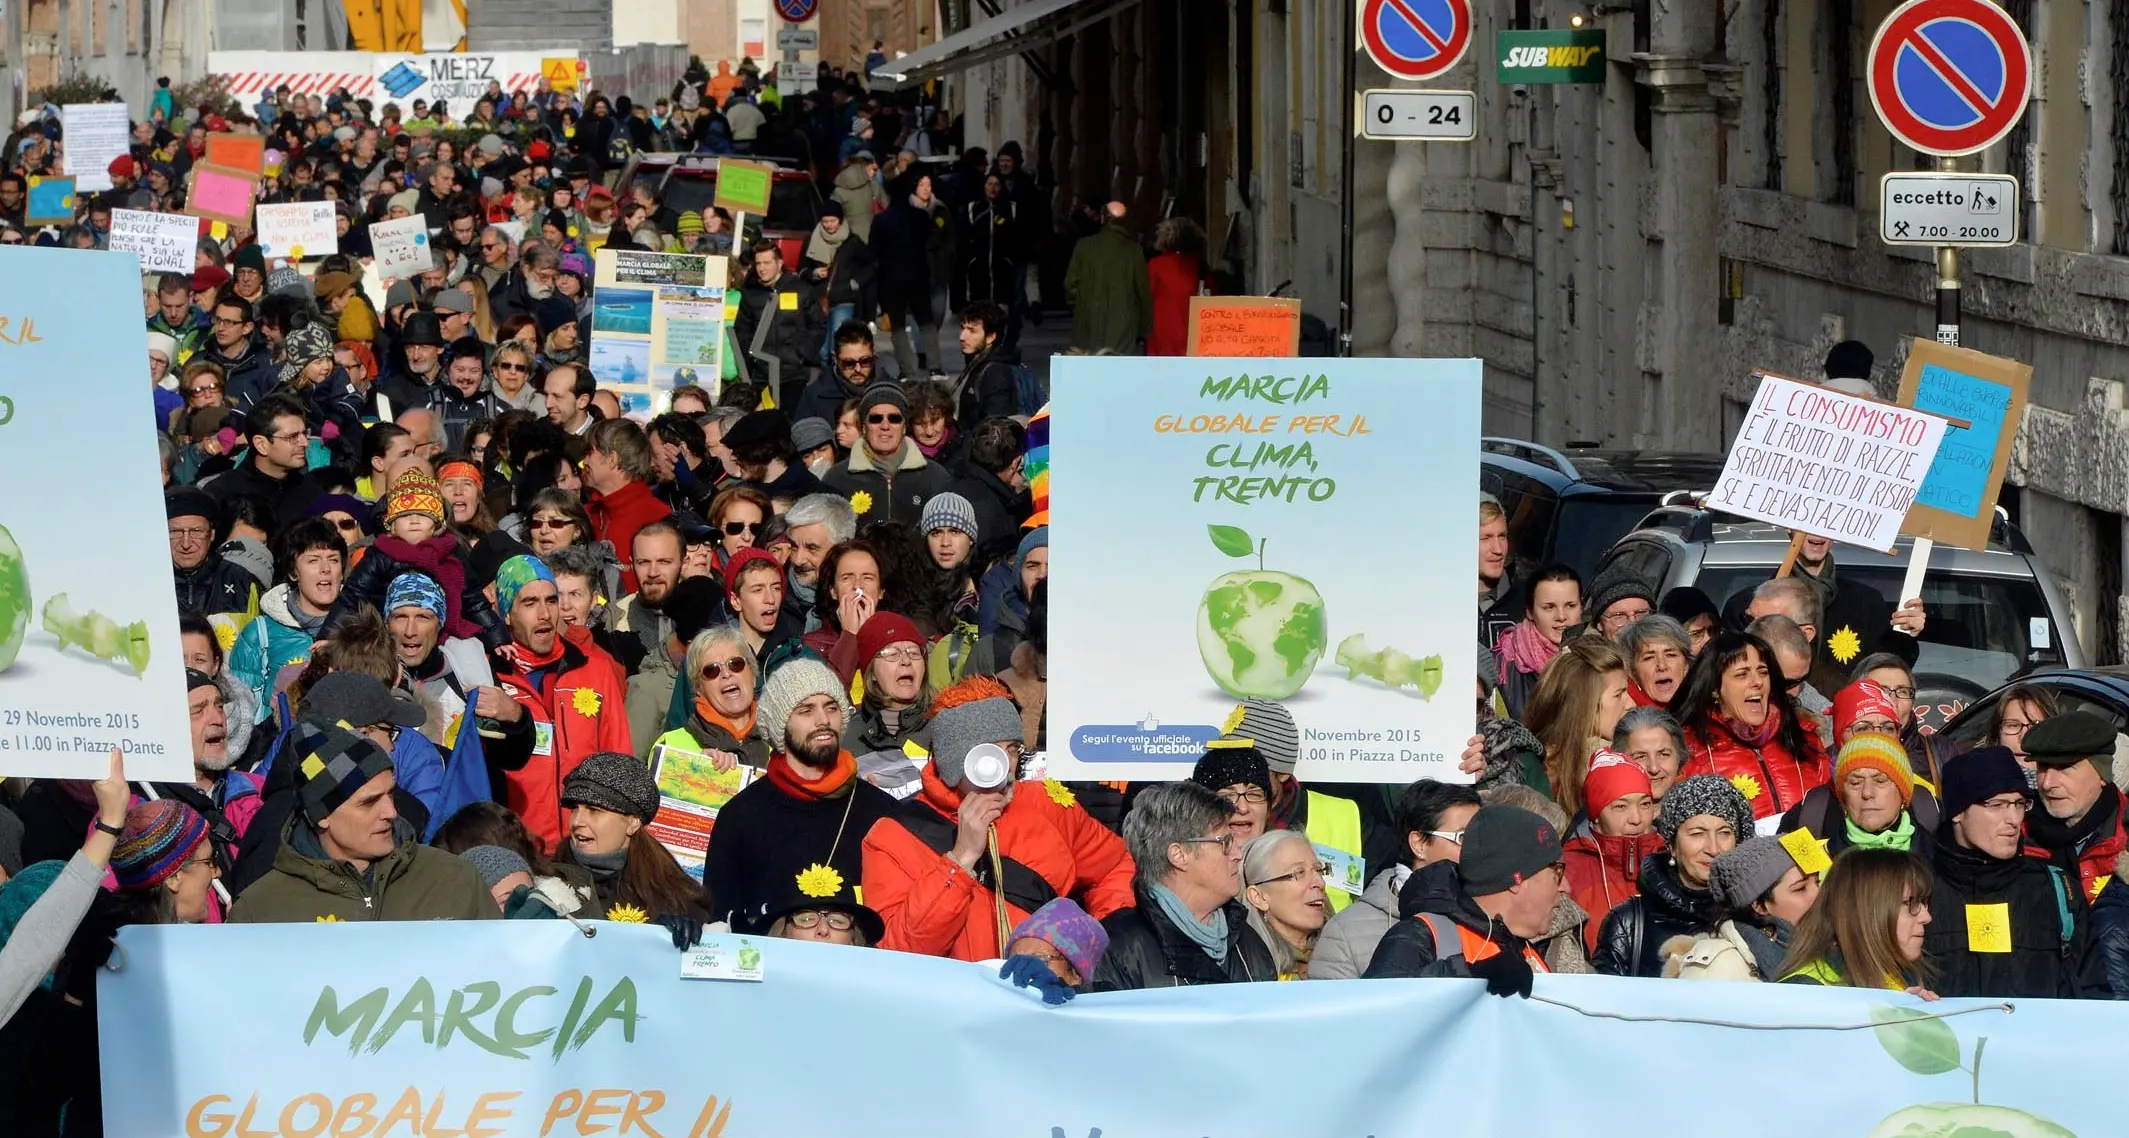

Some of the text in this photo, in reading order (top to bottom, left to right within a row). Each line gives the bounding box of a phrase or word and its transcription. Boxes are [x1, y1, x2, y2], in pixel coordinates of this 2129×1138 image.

[1502, 46, 1600, 67] SUBWAY
[431, 57, 494, 80] MERZ
[1428, 105, 1461, 125] 24
[1893, 190, 1964, 205] eccetto
[162, 238, 175, 246] LA
[1919, 226, 1948, 237] 7.00
[1960, 227, 1999, 238] 20.00
[140, 255, 186, 269] ZIONAL
[1200, 373, 1331, 405] MARCIA
[1154, 412, 1373, 437] GLOBALE PER IL
[1757, 383, 1927, 447] IL CONSUMISMO
[1206, 441, 1319, 473] CLIMA,
[1762, 418, 1778, 446] IL
[1777, 421, 1834, 458] FRUTTO
[1833, 436, 1854, 465] DI
[1854, 441, 1919, 483] RAZZIE,
[1730, 445, 1846, 497] SFRUTTAMENTO
[1849, 474, 1870, 502] DI
[1193, 474, 1336, 505] TRENTO
[1718, 478, 1883, 541] SE E DEVASTAZIONI.
[4, 710, 140, 729] 29 Novembre 2015
[16, 735, 52, 750] 11.00
[56, 737, 69, 751] in
[74, 737, 117, 753] Piazza
[122, 738, 165, 755] Dante
[1082, 735, 1191, 745] Segui l'evento ufficiale
[1304, 728, 1421, 742] Novembre 2015
[1143, 741, 1205, 754] facebook
[1299, 748, 1444, 762] 1.00 in Piazza Dante
[303, 975, 646, 1065] MARCIA
[184, 1085, 523, 1138] GLOBALE
[539, 1087, 668, 1138] PER
